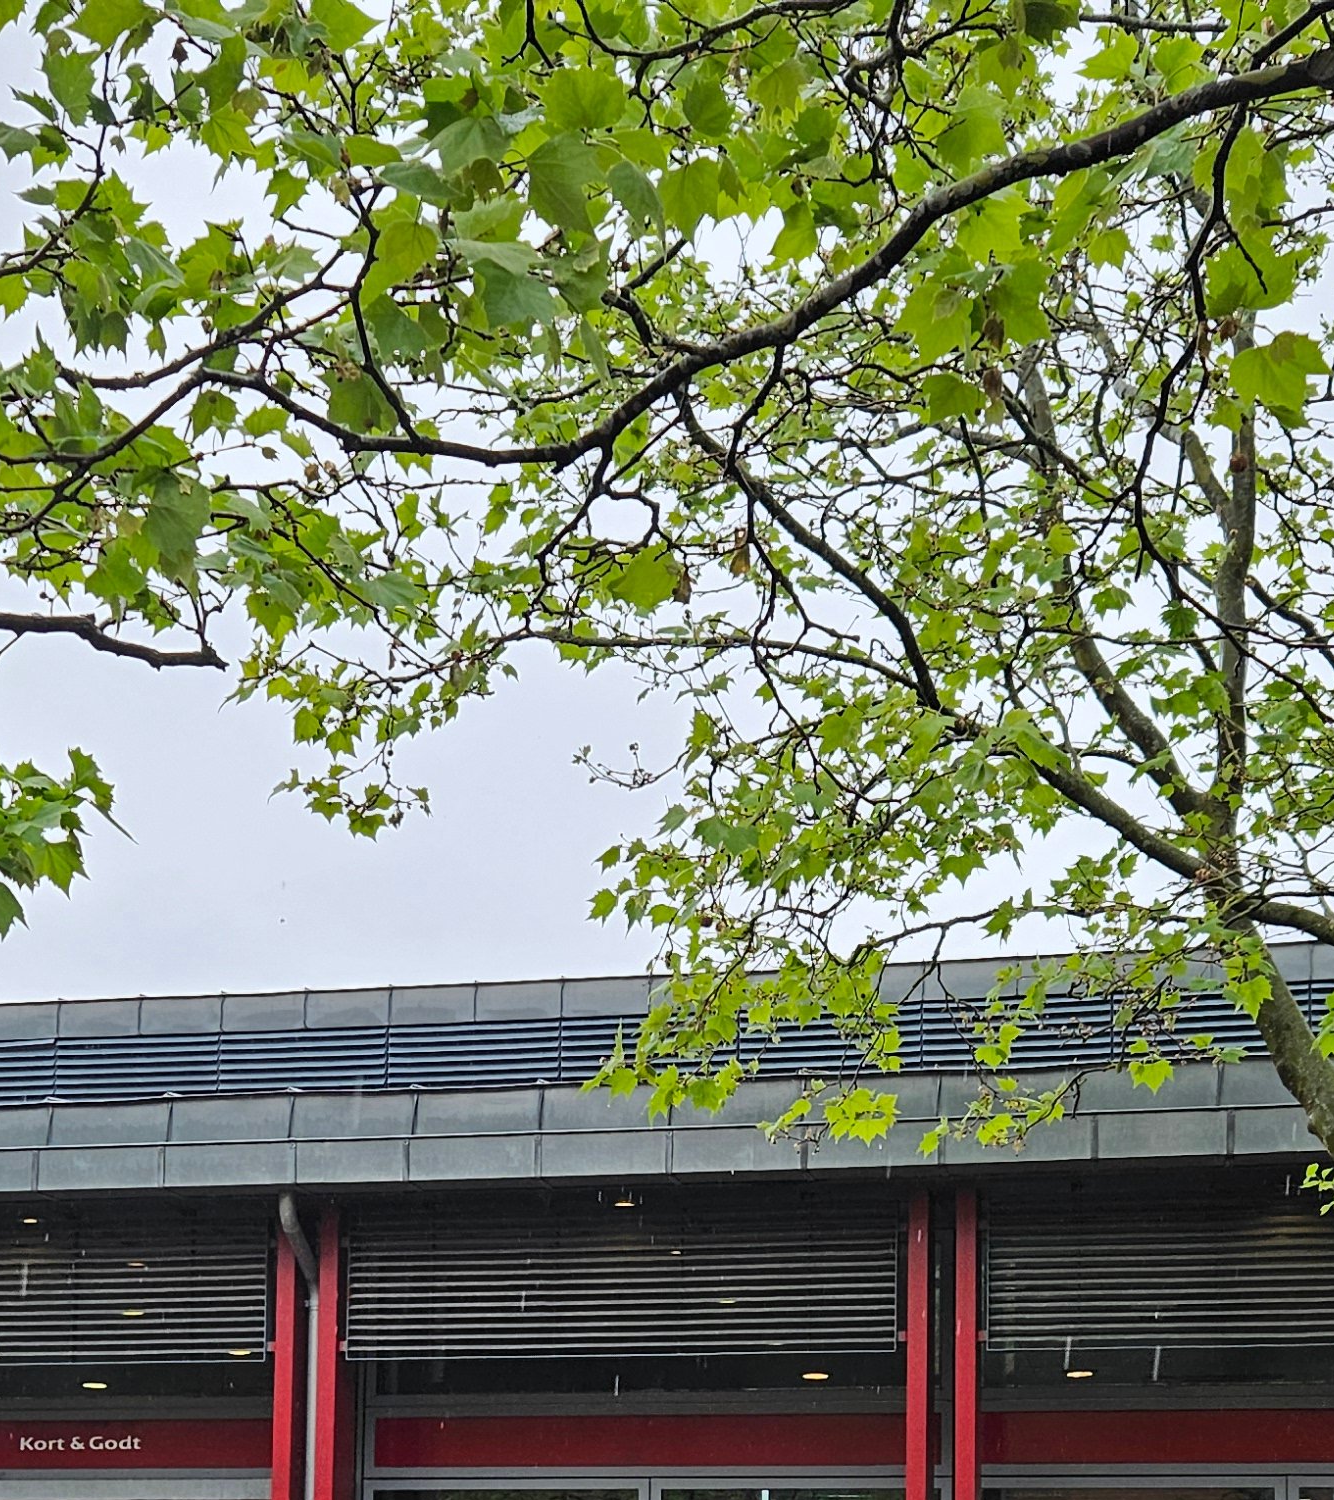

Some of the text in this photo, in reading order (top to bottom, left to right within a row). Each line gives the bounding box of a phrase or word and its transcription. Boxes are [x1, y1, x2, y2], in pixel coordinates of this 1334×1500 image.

[19, 1435, 141, 1451] Kort & Godt
